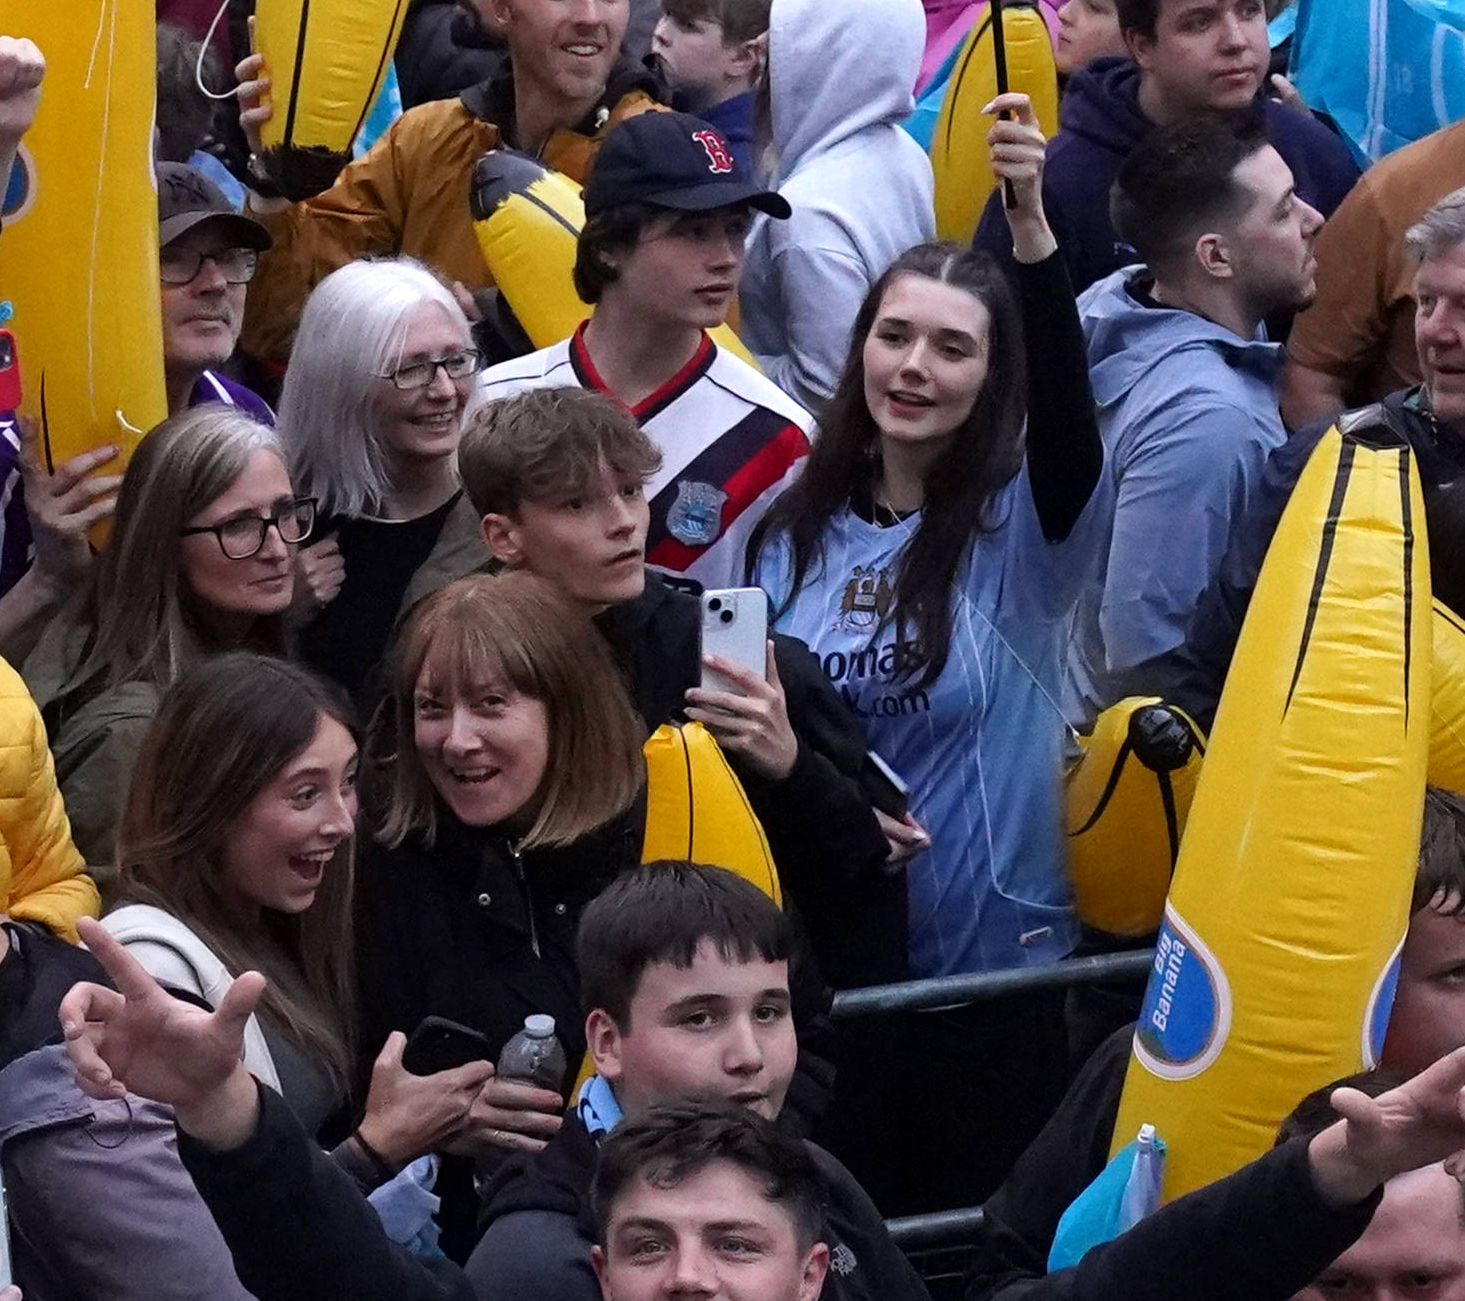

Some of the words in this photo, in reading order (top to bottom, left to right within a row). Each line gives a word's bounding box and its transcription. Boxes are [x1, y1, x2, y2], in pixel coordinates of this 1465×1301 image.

[692, 130, 734, 174] B
[1153, 931, 1173, 976] Big
[1152, 938, 1187, 1032] Banana
